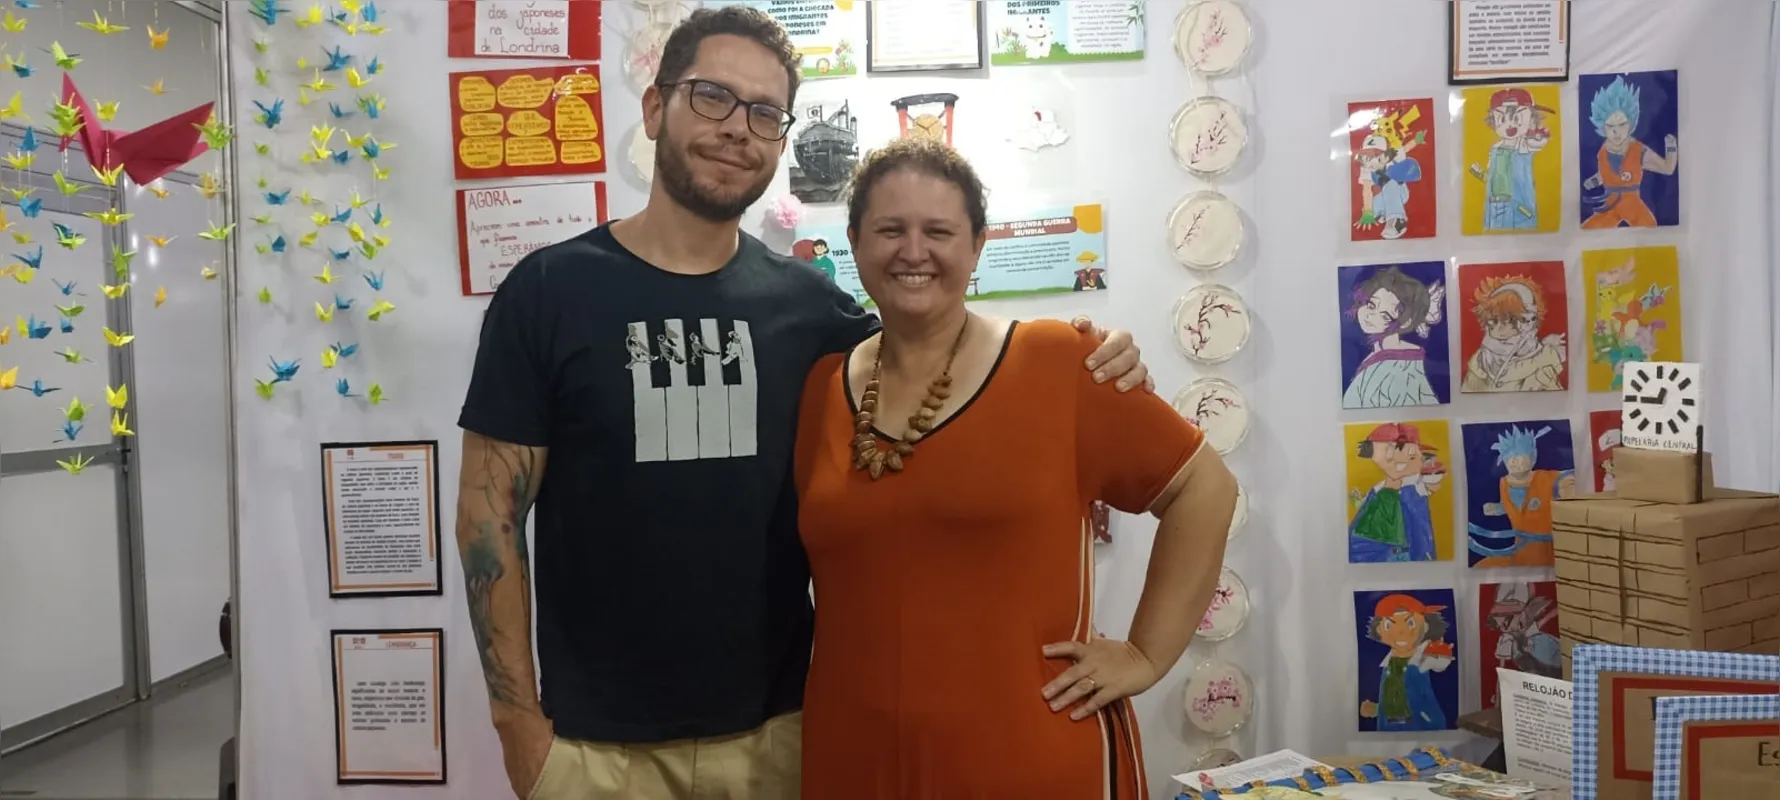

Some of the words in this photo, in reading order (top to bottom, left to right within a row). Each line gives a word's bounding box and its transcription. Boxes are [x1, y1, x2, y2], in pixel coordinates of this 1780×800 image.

[500, 37, 560, 53] Londrina
[1010, 221, 1042, 230] SEGUNDA
[1043, 218, 1071, 226] GUERRA
[1014, 228, 1046, 237] MUNDIAL
[1663, 439, 1697, 450] CENTRAL
